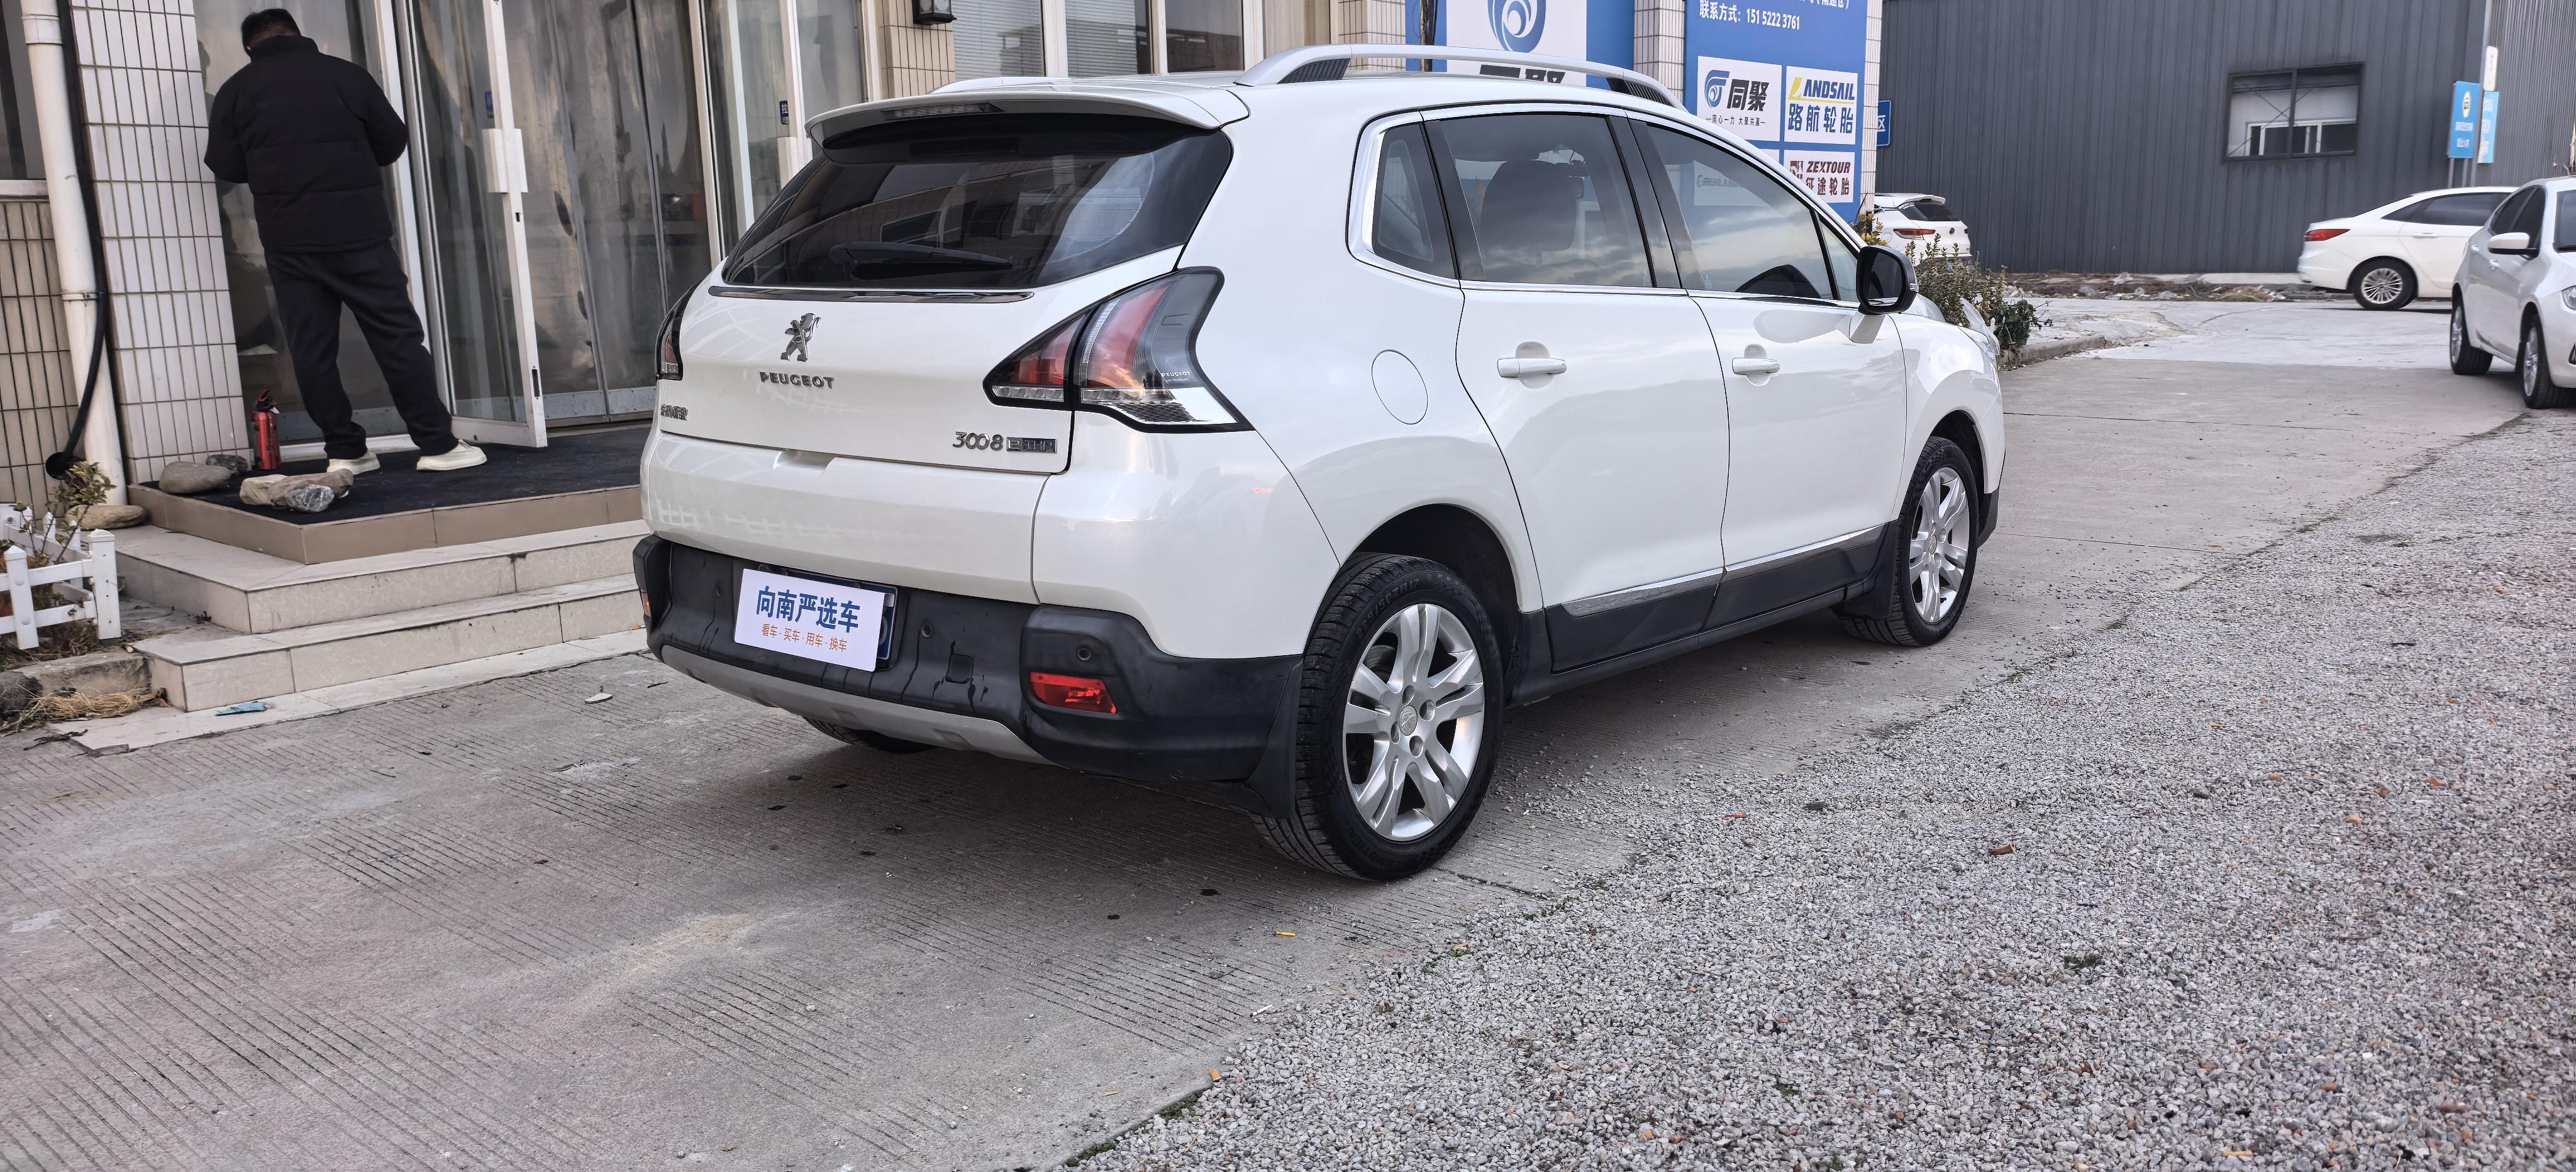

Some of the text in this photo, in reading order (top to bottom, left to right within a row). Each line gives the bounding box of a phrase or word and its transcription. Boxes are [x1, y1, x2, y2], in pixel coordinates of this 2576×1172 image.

[1746, 8, 1760, 24] 151
[1762, 10, 1780, 27] 5222
[1782, 14, 1800, 30] 3761
[1727, 79, 1769, 112] 同聚
[1788, 77, 1855, 101] LANDSAIL
[1787, 103, 1853, 134] 路航轮胎
[1806, 160, 1851, 174] ZEXTOUR
[759, 371, 835, 389] PEUGEOT
[952, 431, 1004, 451] 3008
[756, 585, 861, 633] 向南严选车
